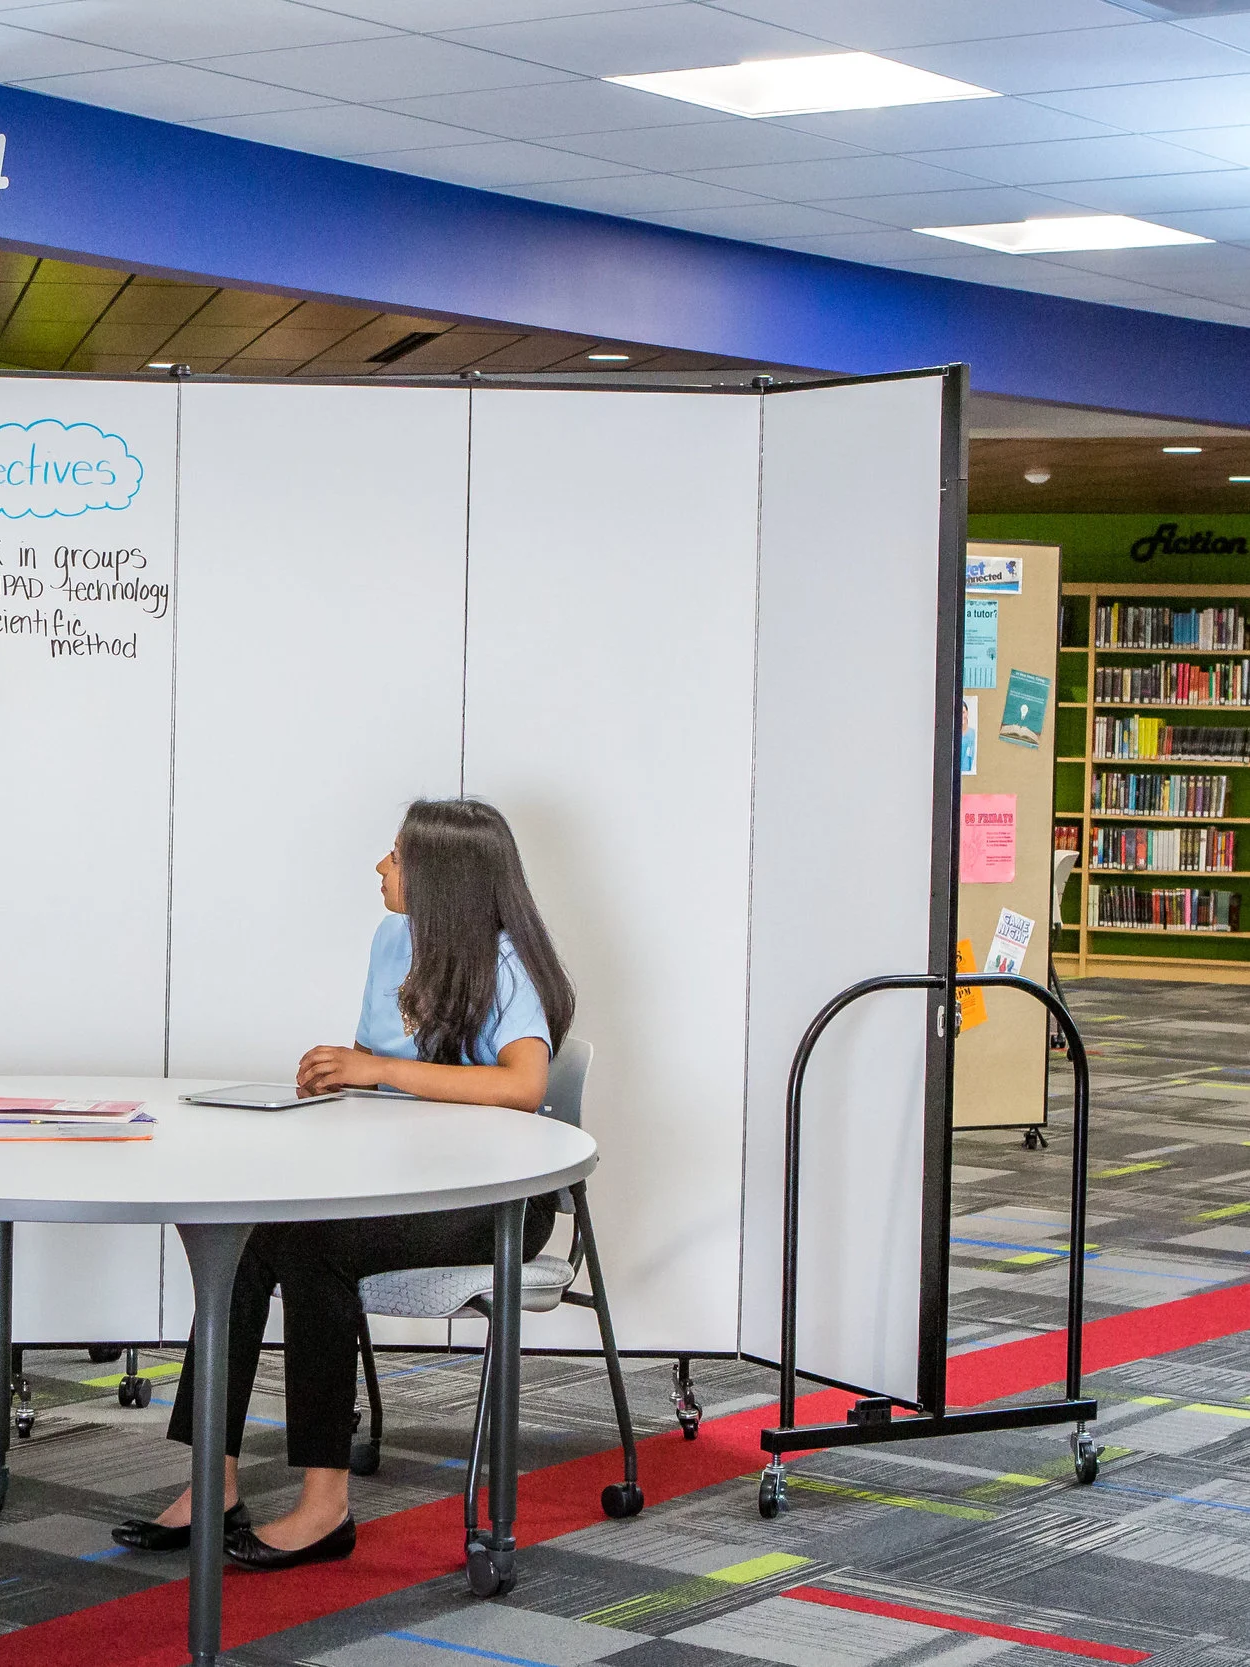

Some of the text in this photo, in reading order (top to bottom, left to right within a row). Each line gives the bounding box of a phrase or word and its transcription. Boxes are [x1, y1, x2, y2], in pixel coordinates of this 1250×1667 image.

[1130, 522, 1248, 563] Fiction
[19, 541, 37, 569] in
[50, 546, 147, 588] groups
[966, 572, 1002, 584] nnected
[62, 577, 169, 618] technology
[51, 633, 137, 658] method
[998, 922, 1029, 945] NIGHT
[1004, 914, 1030, 933] GAME
